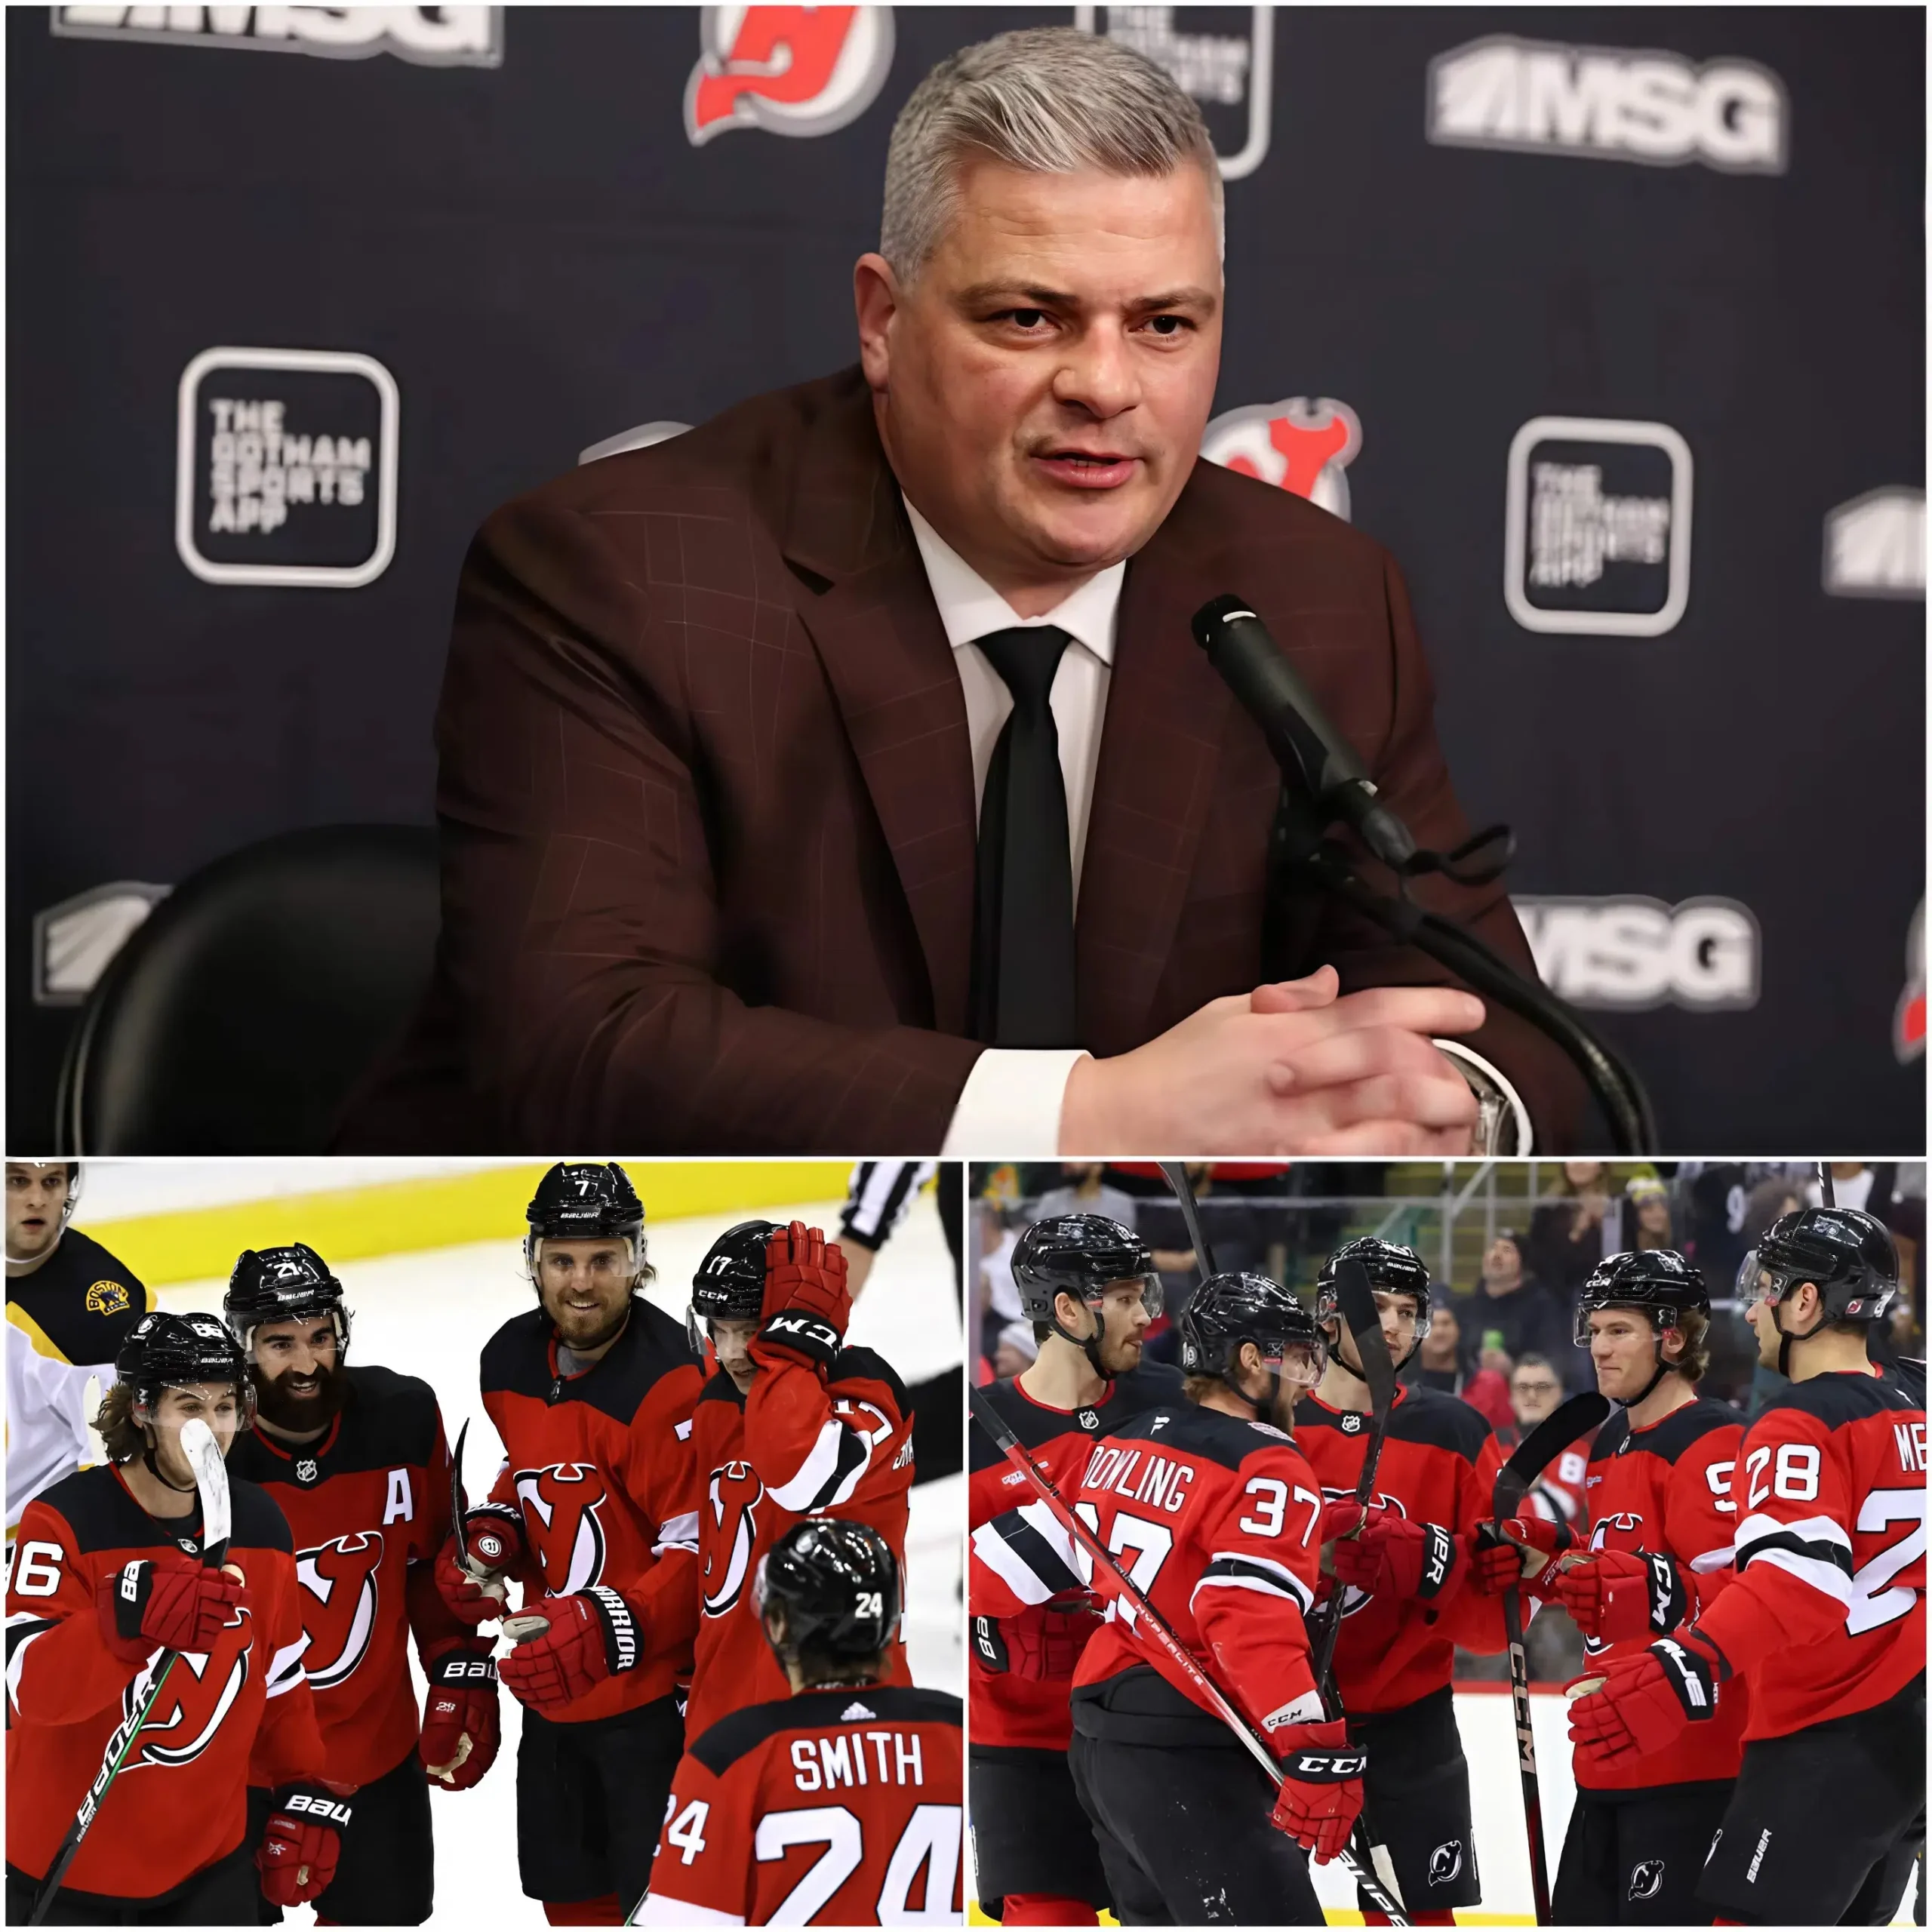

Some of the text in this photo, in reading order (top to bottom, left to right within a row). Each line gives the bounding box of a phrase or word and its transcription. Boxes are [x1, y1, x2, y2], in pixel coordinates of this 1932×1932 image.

[1529, 48, 1780, 165] MSG
[575, 1180, 589, 1196] 7
[698, 1289, 728, 1301] CCM
[383, 1468, 413, 1524] A
[1746, 1443, 1820, 1510] 28
[1240, 1477, 1321, 1548] 37
[6, 1540, 63, 1596] 6
[855, 1592, 882, 1618] 24
[1268, 1709, 1303, 1727] CCM
[1510, 1641, 1536, 1774] CCM
[791, 1732, 923, 1792] SMITH
